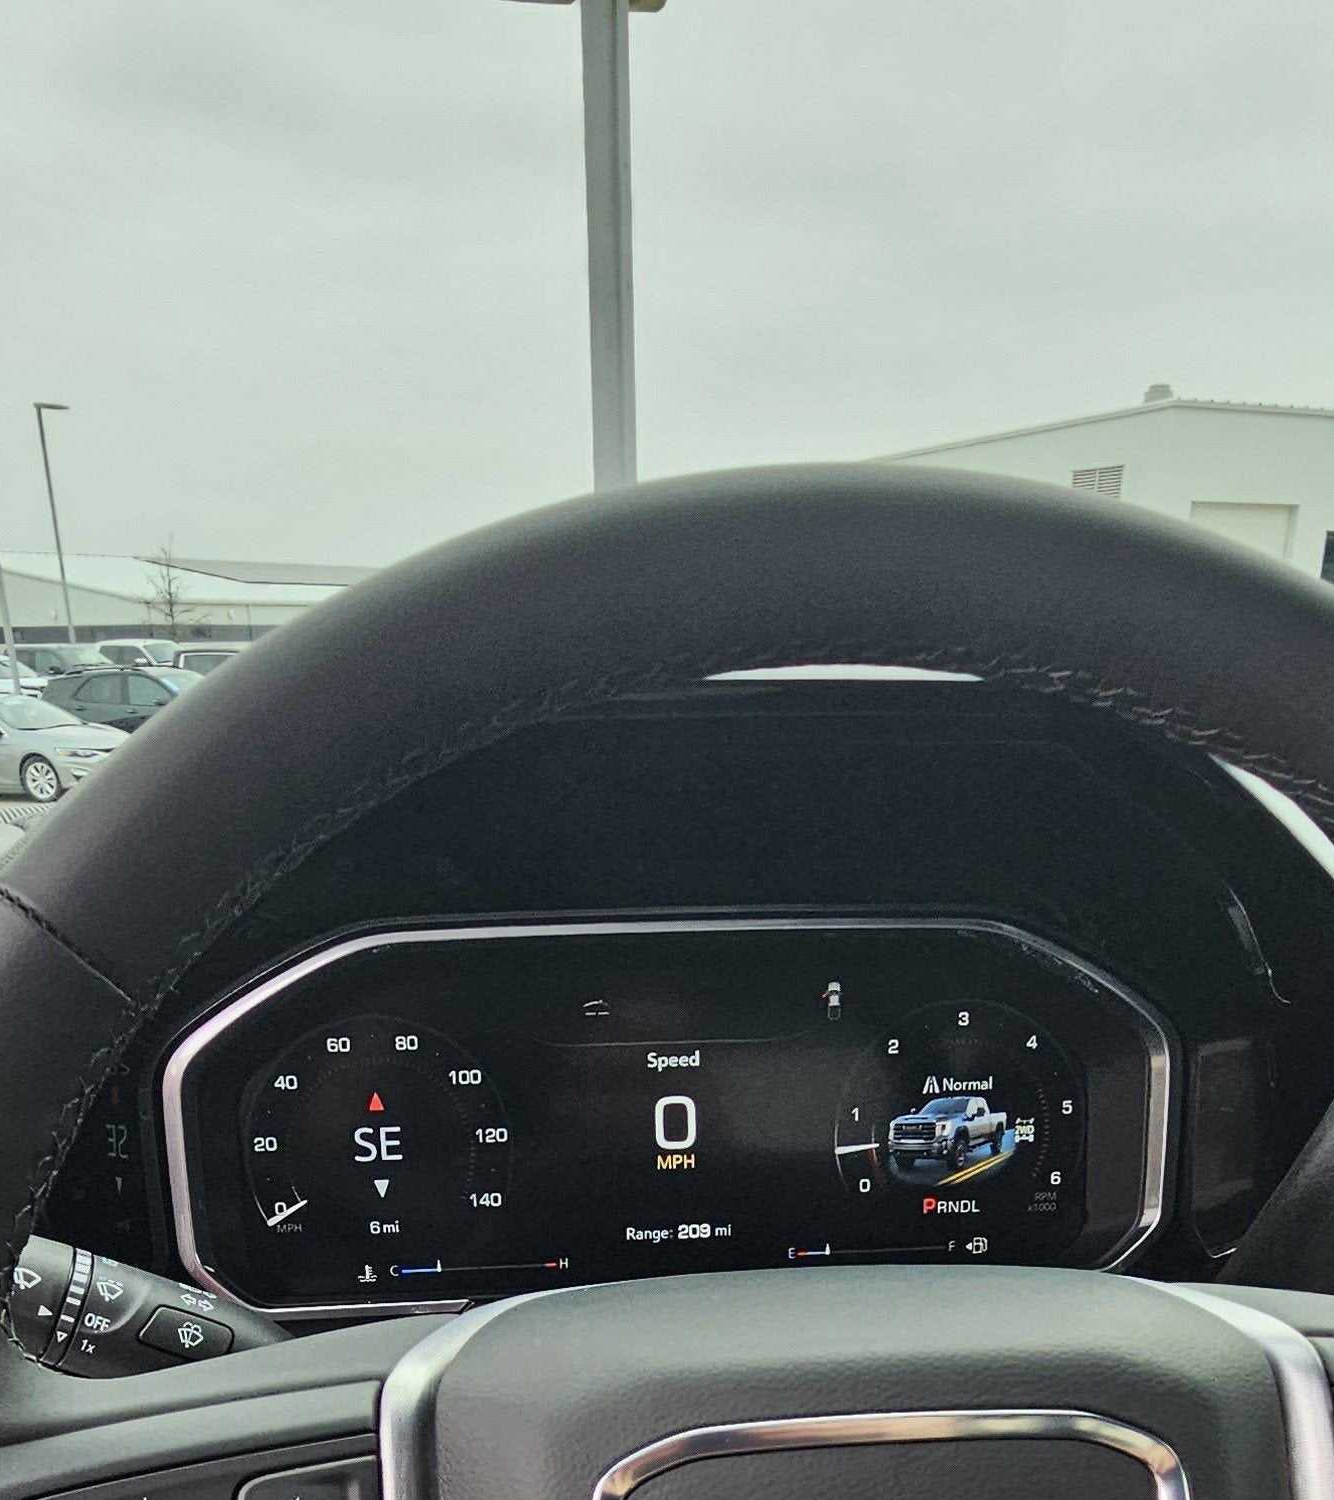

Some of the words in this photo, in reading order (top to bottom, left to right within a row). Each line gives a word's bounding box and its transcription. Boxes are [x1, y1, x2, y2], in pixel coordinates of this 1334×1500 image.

[958, 1011, 970, 1026] 3
[326, 1038, 351, 1053] 60
[395, 1035, 418, 1051] 80
[887, 1039, 899, 1054] 2
[1026, 1035, 1038, 1050] 4
[647, 1050, 701, 1072] Speed
[274, 1075, 298, 1090] 40
[448, 1069, 482, 1085] 100
[942, 1076, 993, 1091] Normal
[851, 1108, 860, 1122] 1
[1062, 1100, 1073, 1115] 5
[655, 1095, 696, 1150] 0
[475, 1128, 508, 1143] 120
[254, 1137, 278, 1152] 20
[354, 1126, 403, 1162] SE
[657, 1154, 695, 1170] MPH
[1050, 1171, 1062, 1185] 6
[859, 1179, 871, 1193] 0
[470, 1192, 502, 1208] 140
[1034, 1191, 1057, 1200] RPM
[274, 1202, 287, 1217] 0
[277, 1223, 303, 1234] MPH
[369, 1220, 381, 1234] 6
[383, 1219, 400, 1234] mi
[626, 1227, 674, 1243] Range:
[677, 1223, 711, 1239] 209
[714, 1223, 732, 1237] mi
[788, 1247, 796, 1259] E
[949, 1240, 956, 1252] F
[390, 1265, 399, 1277] C
[559, 1258, 568, 1269] H
[84, 1312, 110, 1331] OFF
